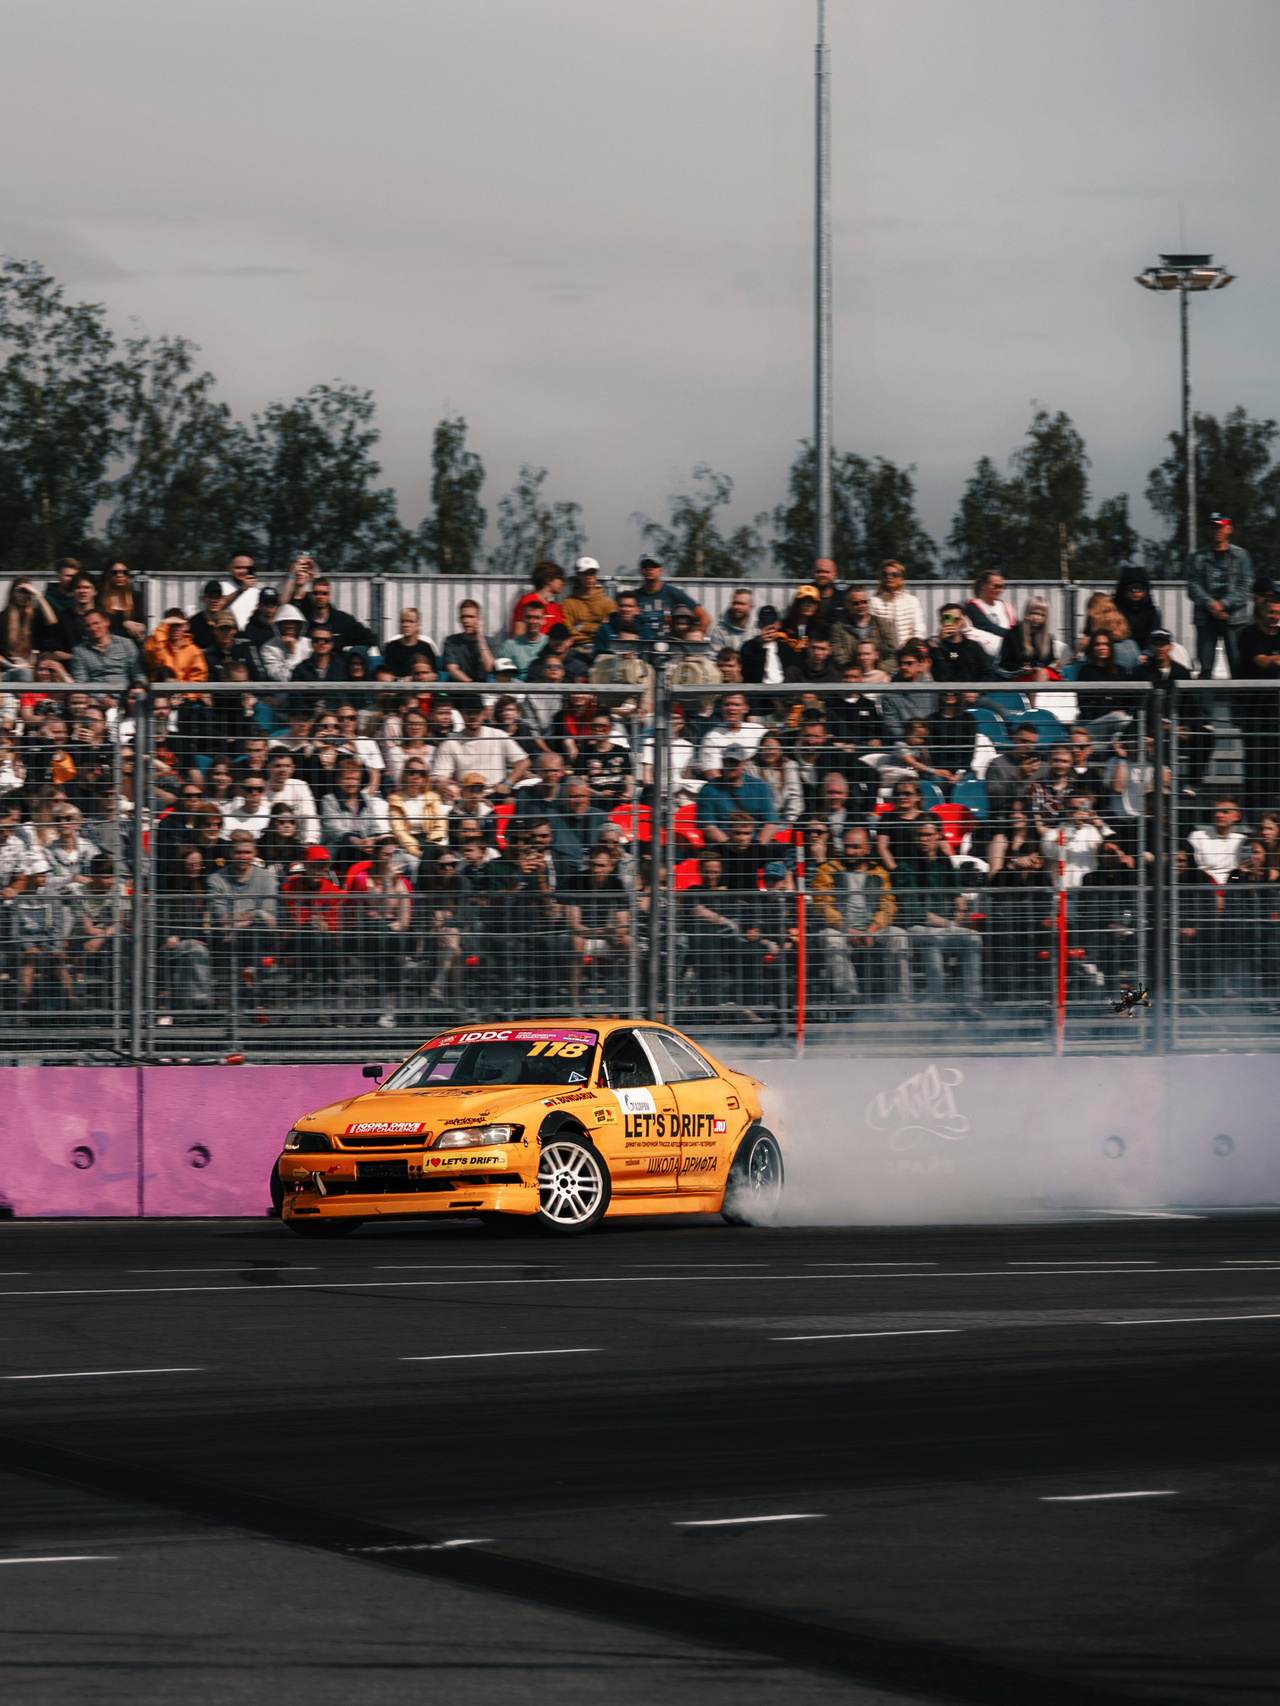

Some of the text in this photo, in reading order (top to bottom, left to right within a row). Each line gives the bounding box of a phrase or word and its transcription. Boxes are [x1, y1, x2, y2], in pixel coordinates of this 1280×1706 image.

[459, 1031, 512, 1042] IDDC
[526, 1041, 588, 1058] 118
[624, 1114, 666, 1138] LET'S
[441, 1157, 468, 1166] LET'S
[470, 1156, 498, 1165] DRIFT
[647, 1156, 718, 1175] ШКОЛА ДРИФТА
